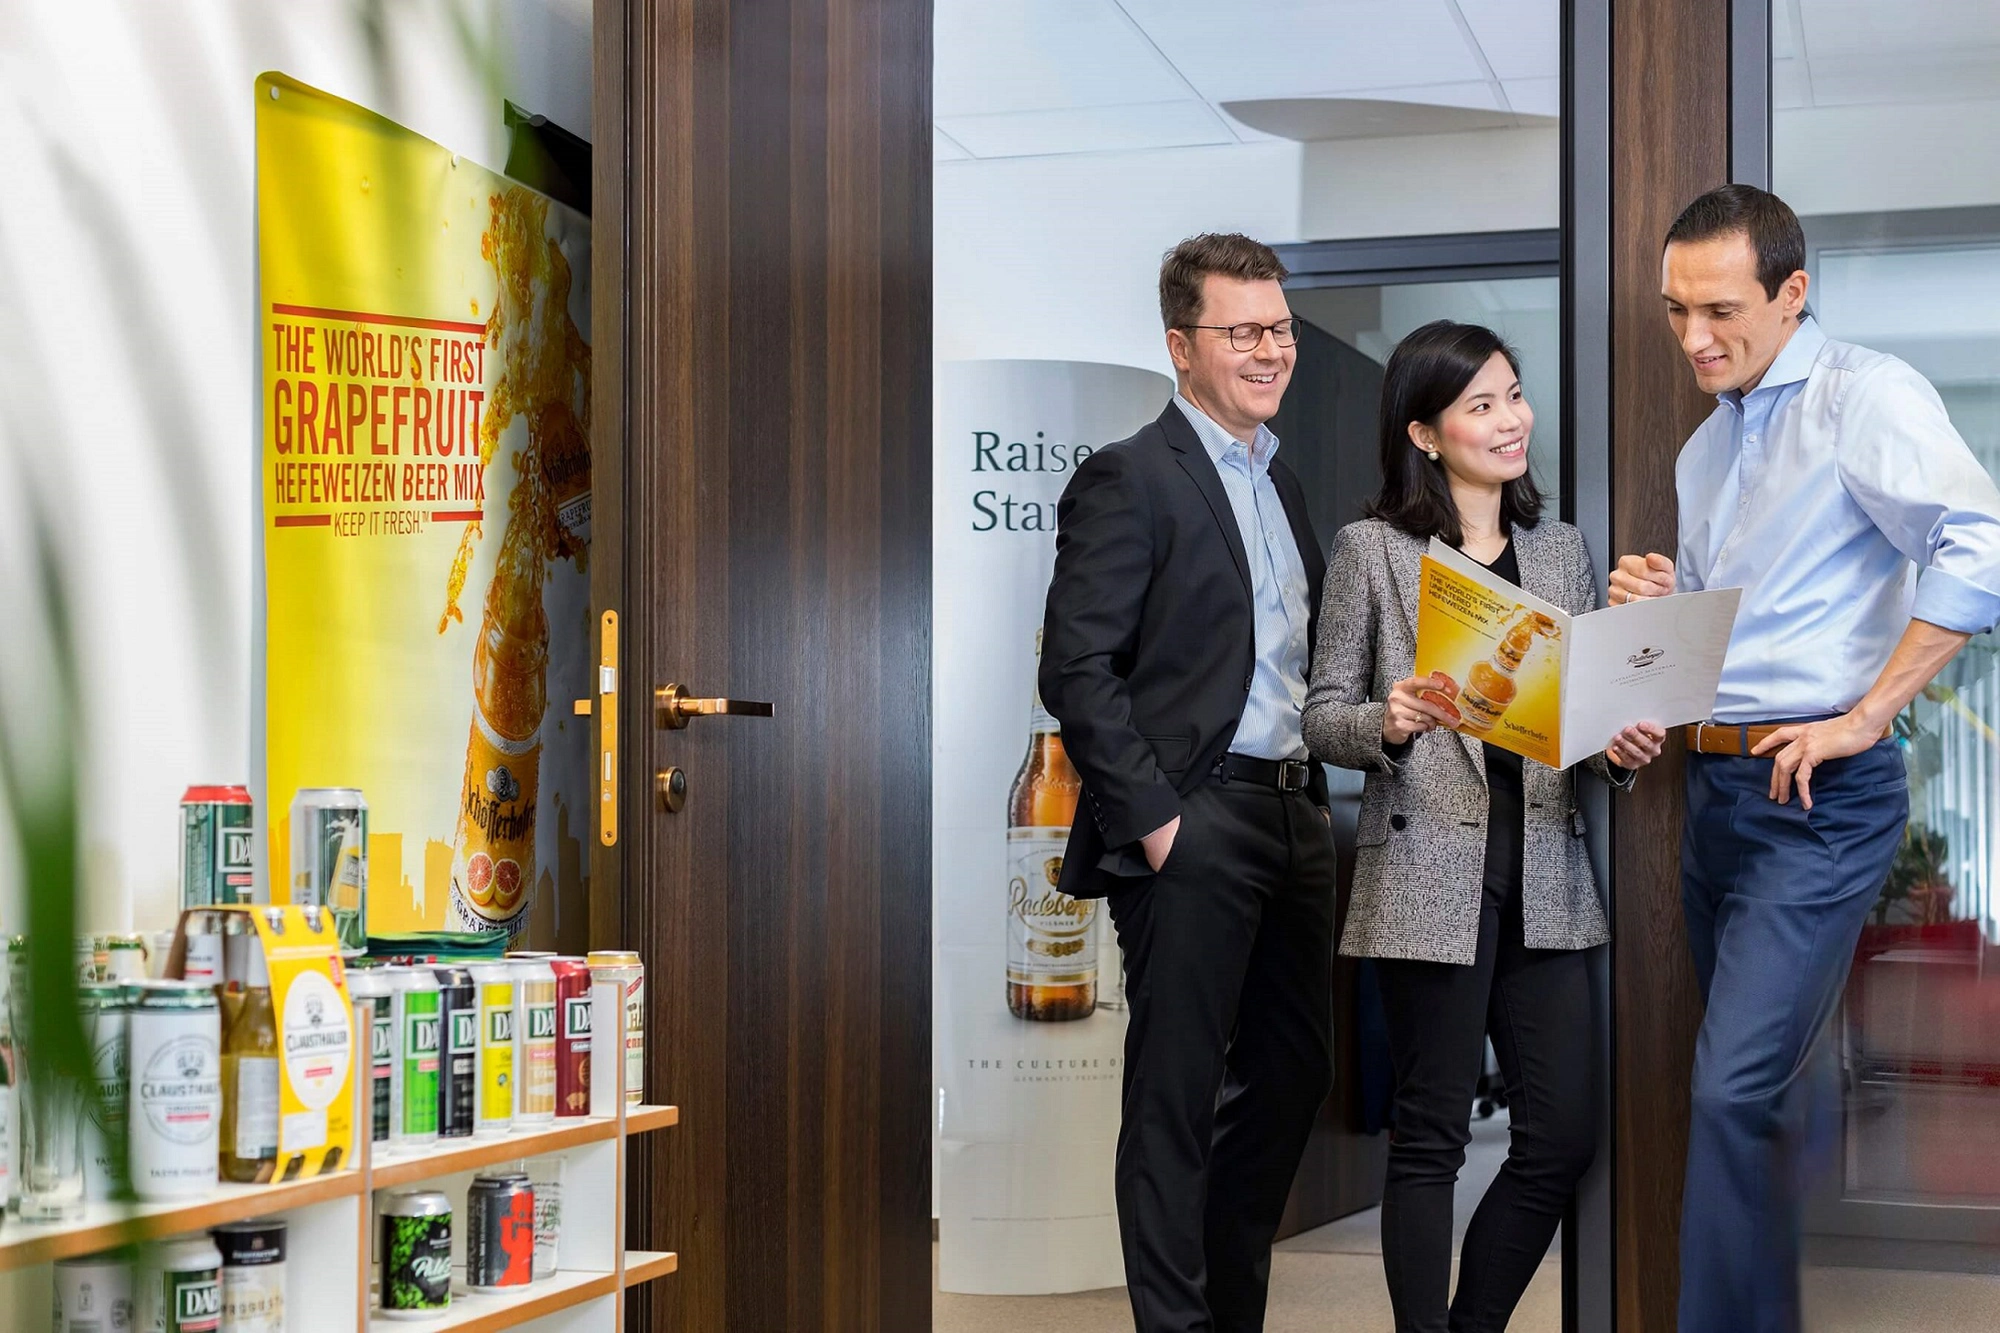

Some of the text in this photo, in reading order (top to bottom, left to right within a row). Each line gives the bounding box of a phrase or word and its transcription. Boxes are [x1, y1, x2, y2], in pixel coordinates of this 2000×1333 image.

[272, 323, 486, 385] THE WORLD'S FIRST
[274, 378, 485, 457] GRAPEFRUIT
[971, 431, 1093, 473] Raise
[275, 462, 486, 504] HEFEWEIZEN BEER MIX
[334, 512, 366, 537] KEEP
[369, 512, 380, 536] IT
[1429, 574, 1444, 585] THE
[1479, 600, 1500, 615] FIRST
[1429, 581, 1472, 609] UNFILTERED
[229, 835, 253, 864] DA
[533, 1009, 556, 1036] DA
[574, 1004, 592, 1031] DA
[417, 1021, 440, 1050] DA
[969, 1060, 1002, 1069] THE
[1017, 1059, 1099, 1069] CULTURE
